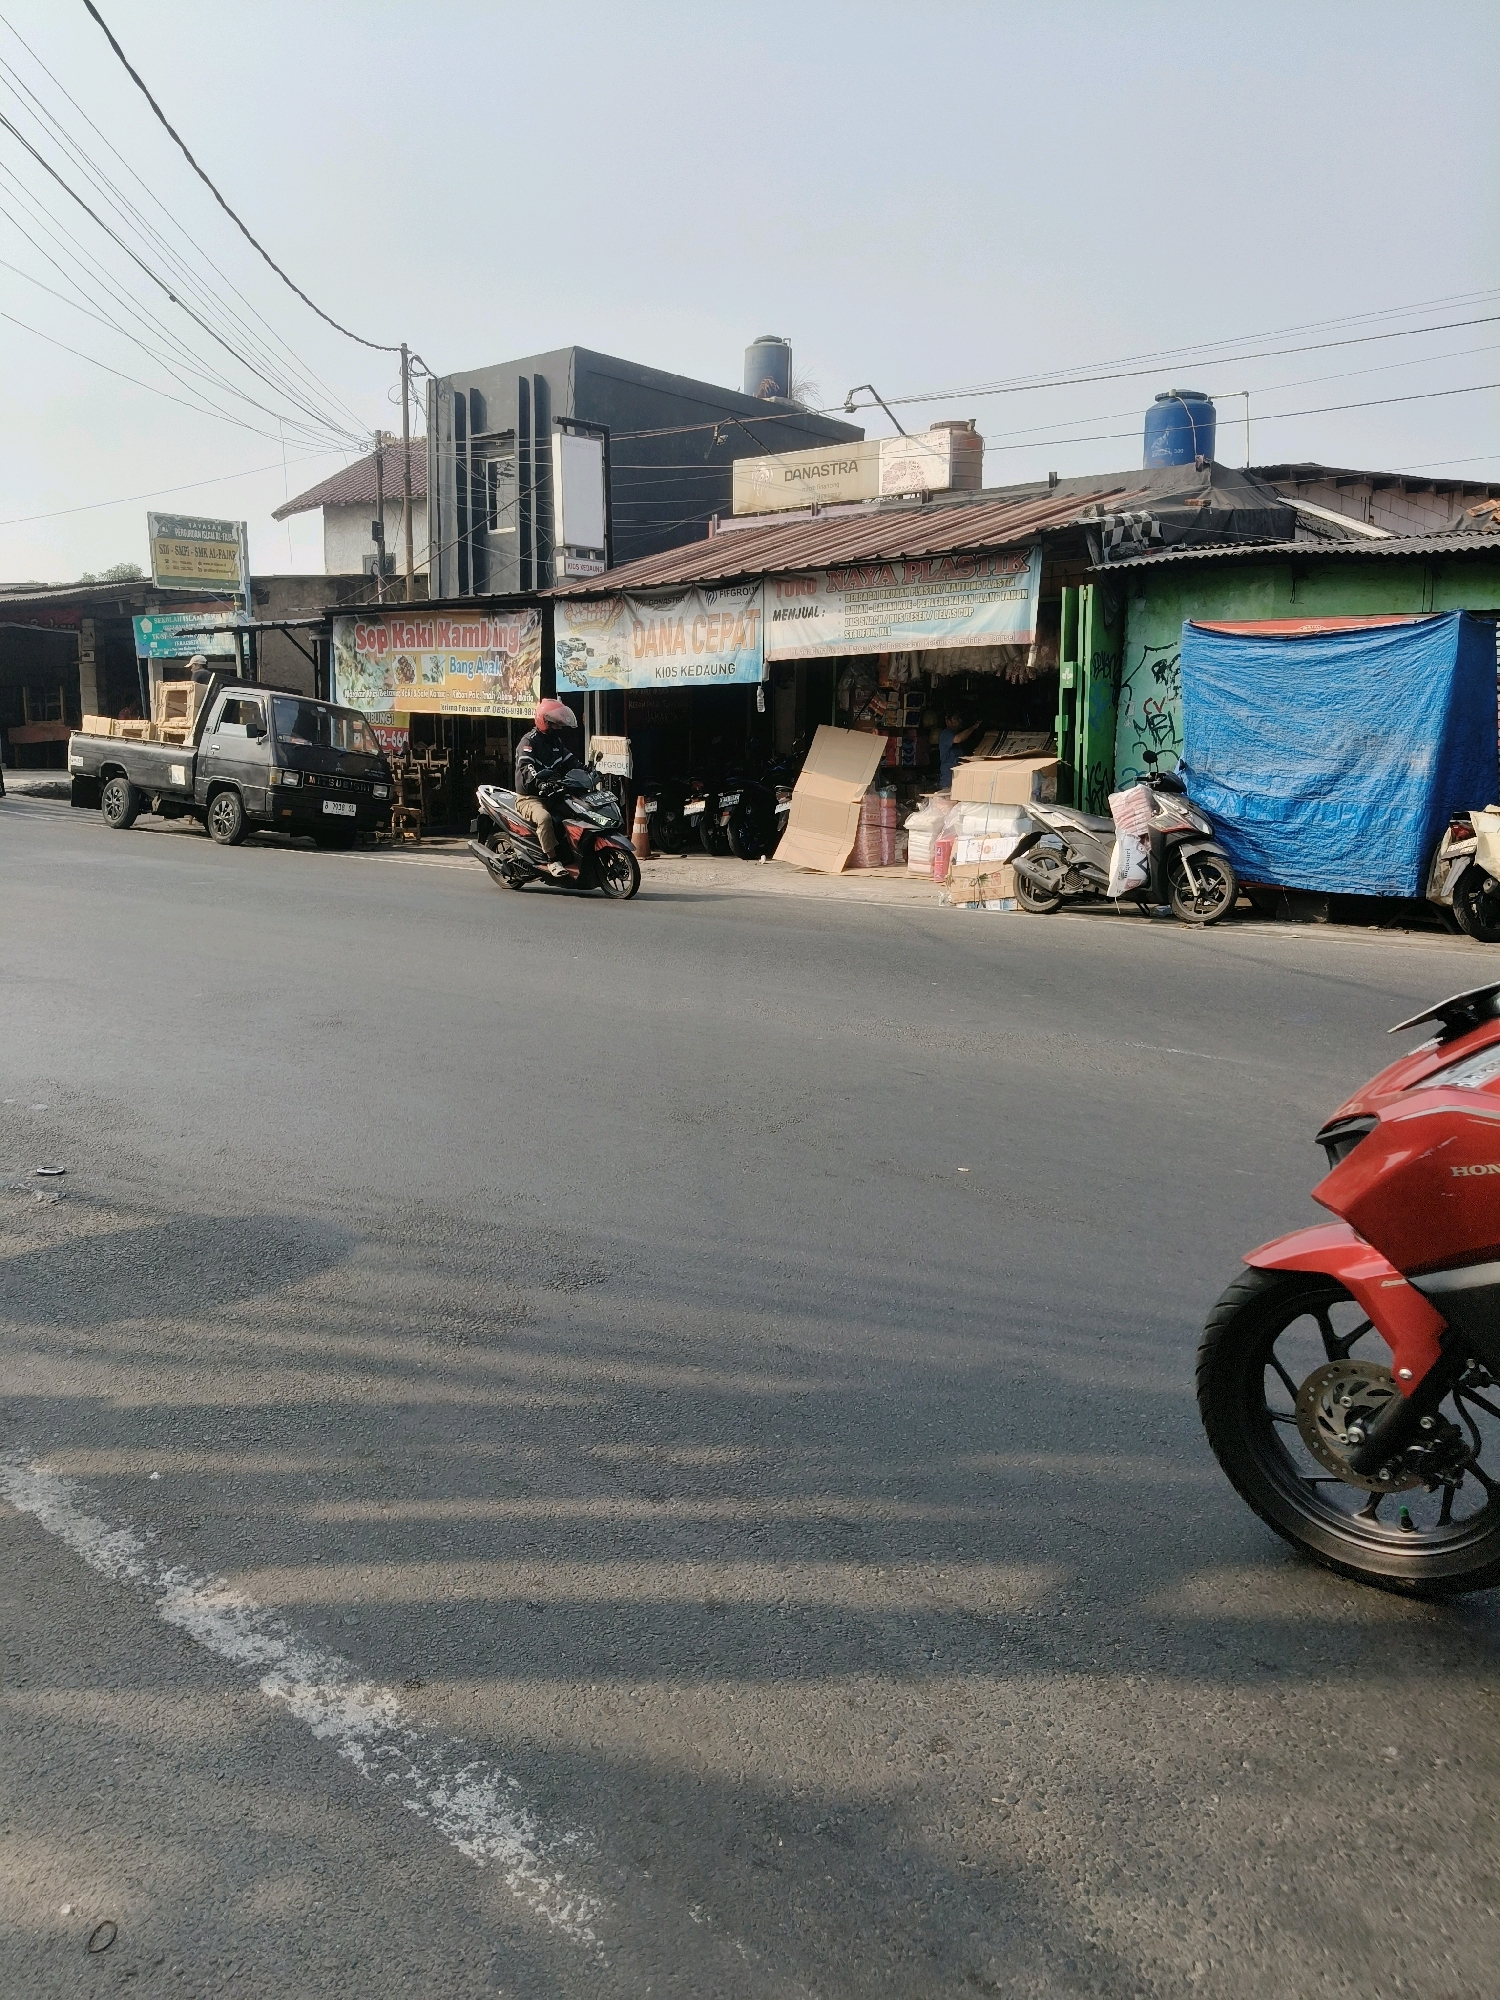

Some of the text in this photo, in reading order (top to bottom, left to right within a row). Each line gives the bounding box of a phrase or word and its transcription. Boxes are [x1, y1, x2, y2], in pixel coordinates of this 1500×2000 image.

[784, 460, 858, 481] DANASTRA
[195, 547, 208, 559] SMK
[825, 549, 1031, 593] NAYA PLASTIK
[775, 576, 817, 598] TOKO
[845, 588, 880, 603] BERBAGAI
[982, 577, 1016, 590] PLASTIK
[845, 601, 869, 615] BAHAN
[898, 599, 913, 610] KUE
[1000, 588, 1029, 601] TAHUN
[958, 606, 974, 618] CUP
[355, 618, 520, 655] Sop Kaki Kambing
[633, 615, 687, 659] DANA
[691, 608, 761, 655] CEPAT
[879, 625, 892, 637] DLL
[449, 656, 474, 679] Bang
[655, 662, 736, 679] KIOS KEDAUNG
[308, 775, 371, 792] MITSUBISHI
